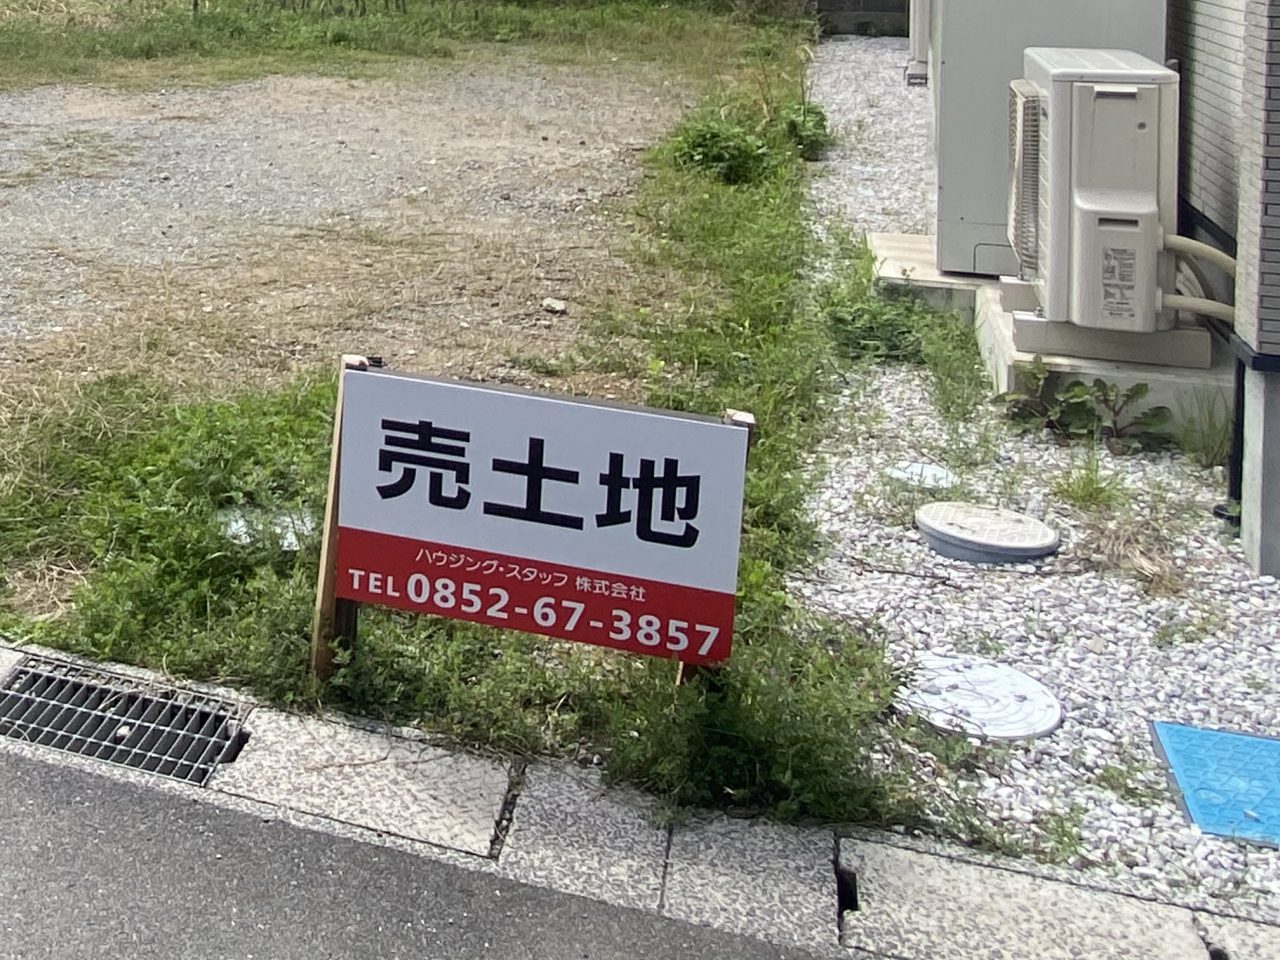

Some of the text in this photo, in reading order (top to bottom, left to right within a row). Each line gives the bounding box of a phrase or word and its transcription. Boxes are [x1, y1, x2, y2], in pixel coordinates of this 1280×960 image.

[376, 419, 701, 548] 売土地
[348, 569, 720, 656] TEL 0852-67-3857
[415, 548, 646, 602] ハウジング・スタッフ 株式会社
